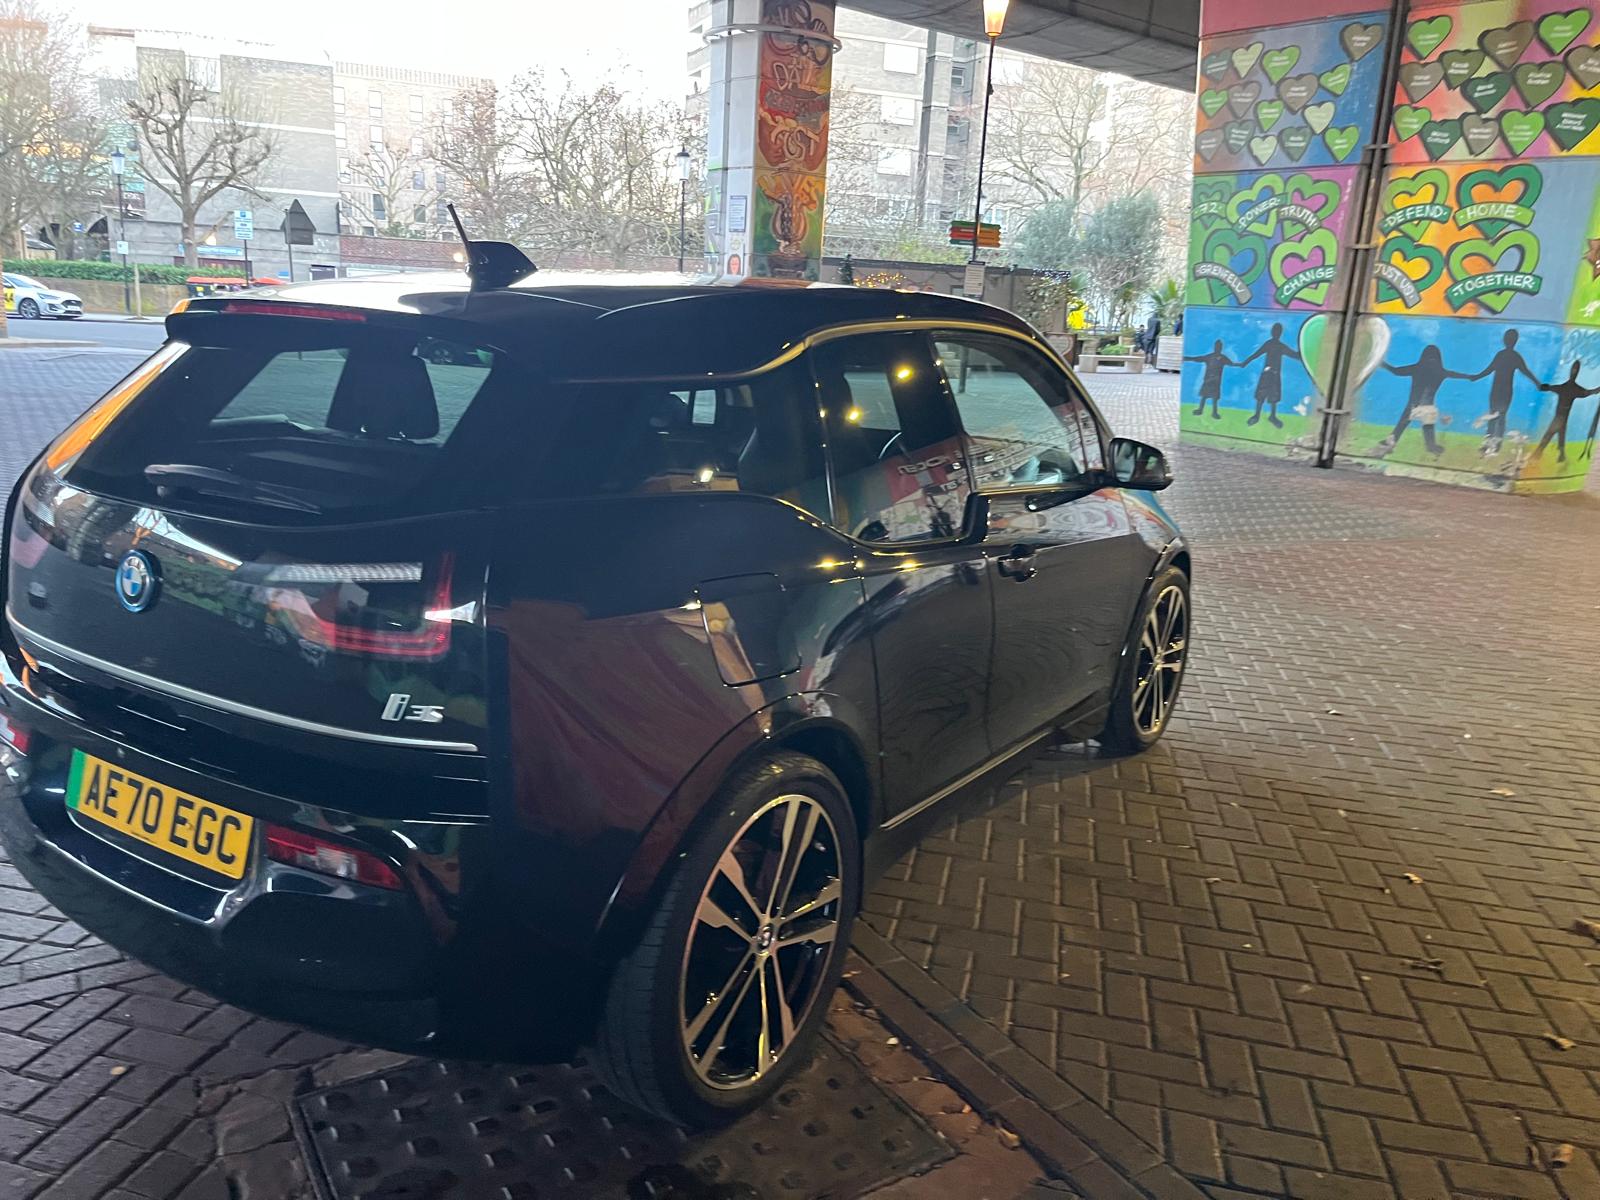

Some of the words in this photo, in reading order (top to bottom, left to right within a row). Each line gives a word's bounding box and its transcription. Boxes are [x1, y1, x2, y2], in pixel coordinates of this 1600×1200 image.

[1238, 197, 1279, 227] POWER
[1280, 206, 1316, 227] TRUTH
[1386, 204, 1443, 227] DEFEND
[1465, 204, 1518, 218] HOME
[1199, 264, 1246, 294] GRENFELL
[1282, 267, 1335, 297] CHANGE
[1457, 274, 1534, 296] TOGETHER
[85, 763, 164, 835] AE70
[168, 795, 243, 865] EGC
